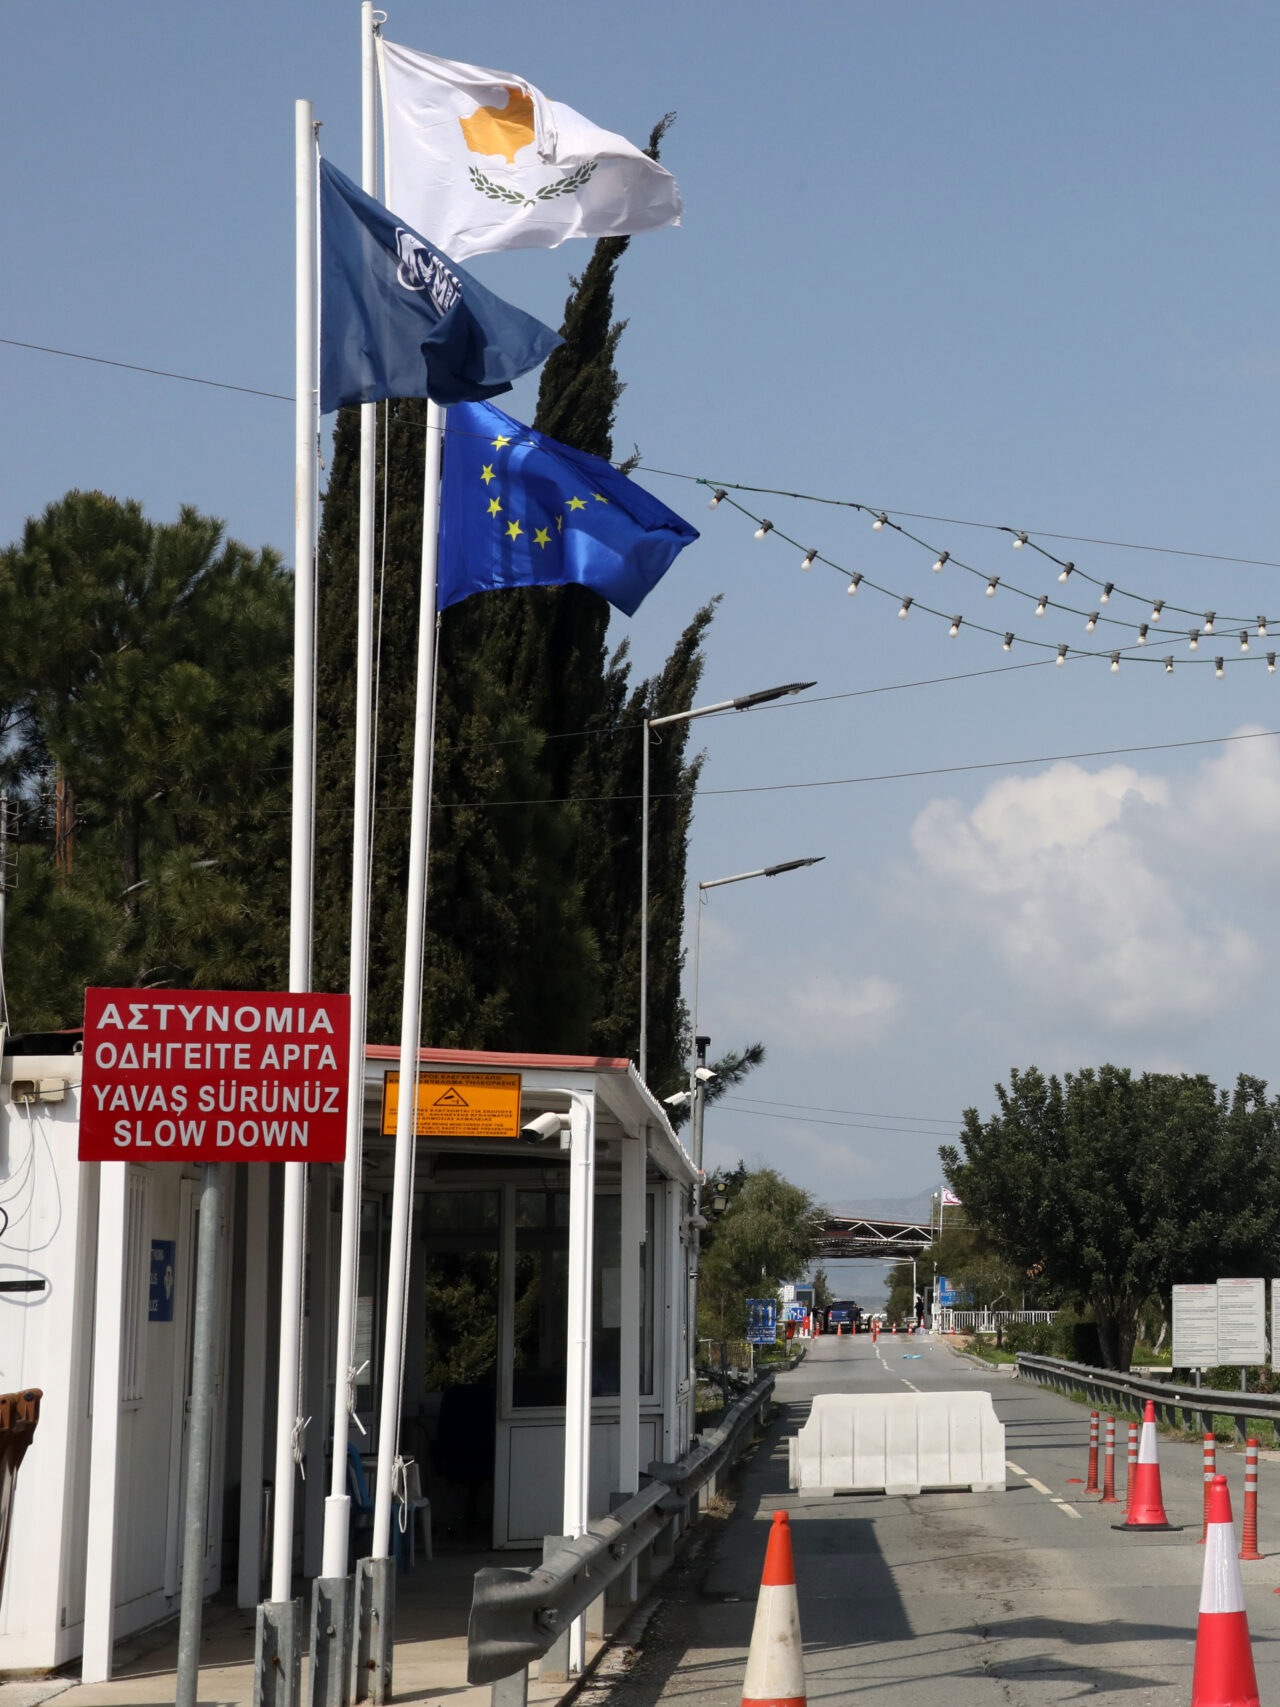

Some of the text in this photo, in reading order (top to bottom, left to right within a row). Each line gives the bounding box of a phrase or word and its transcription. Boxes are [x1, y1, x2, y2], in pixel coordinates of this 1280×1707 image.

[96, 1003, 335, 1034] ΑΣΤΥΝΟΜΙΑ
[95, 1042, 338, 1071] ΟΔΗΓΕΙΤΕ ΑΡΓΑ
[92, 1080, 340, 1116] YAVAŞ SÜRÜNÜZ
[113, 1119, 309, 1147] SLOW DOWN
